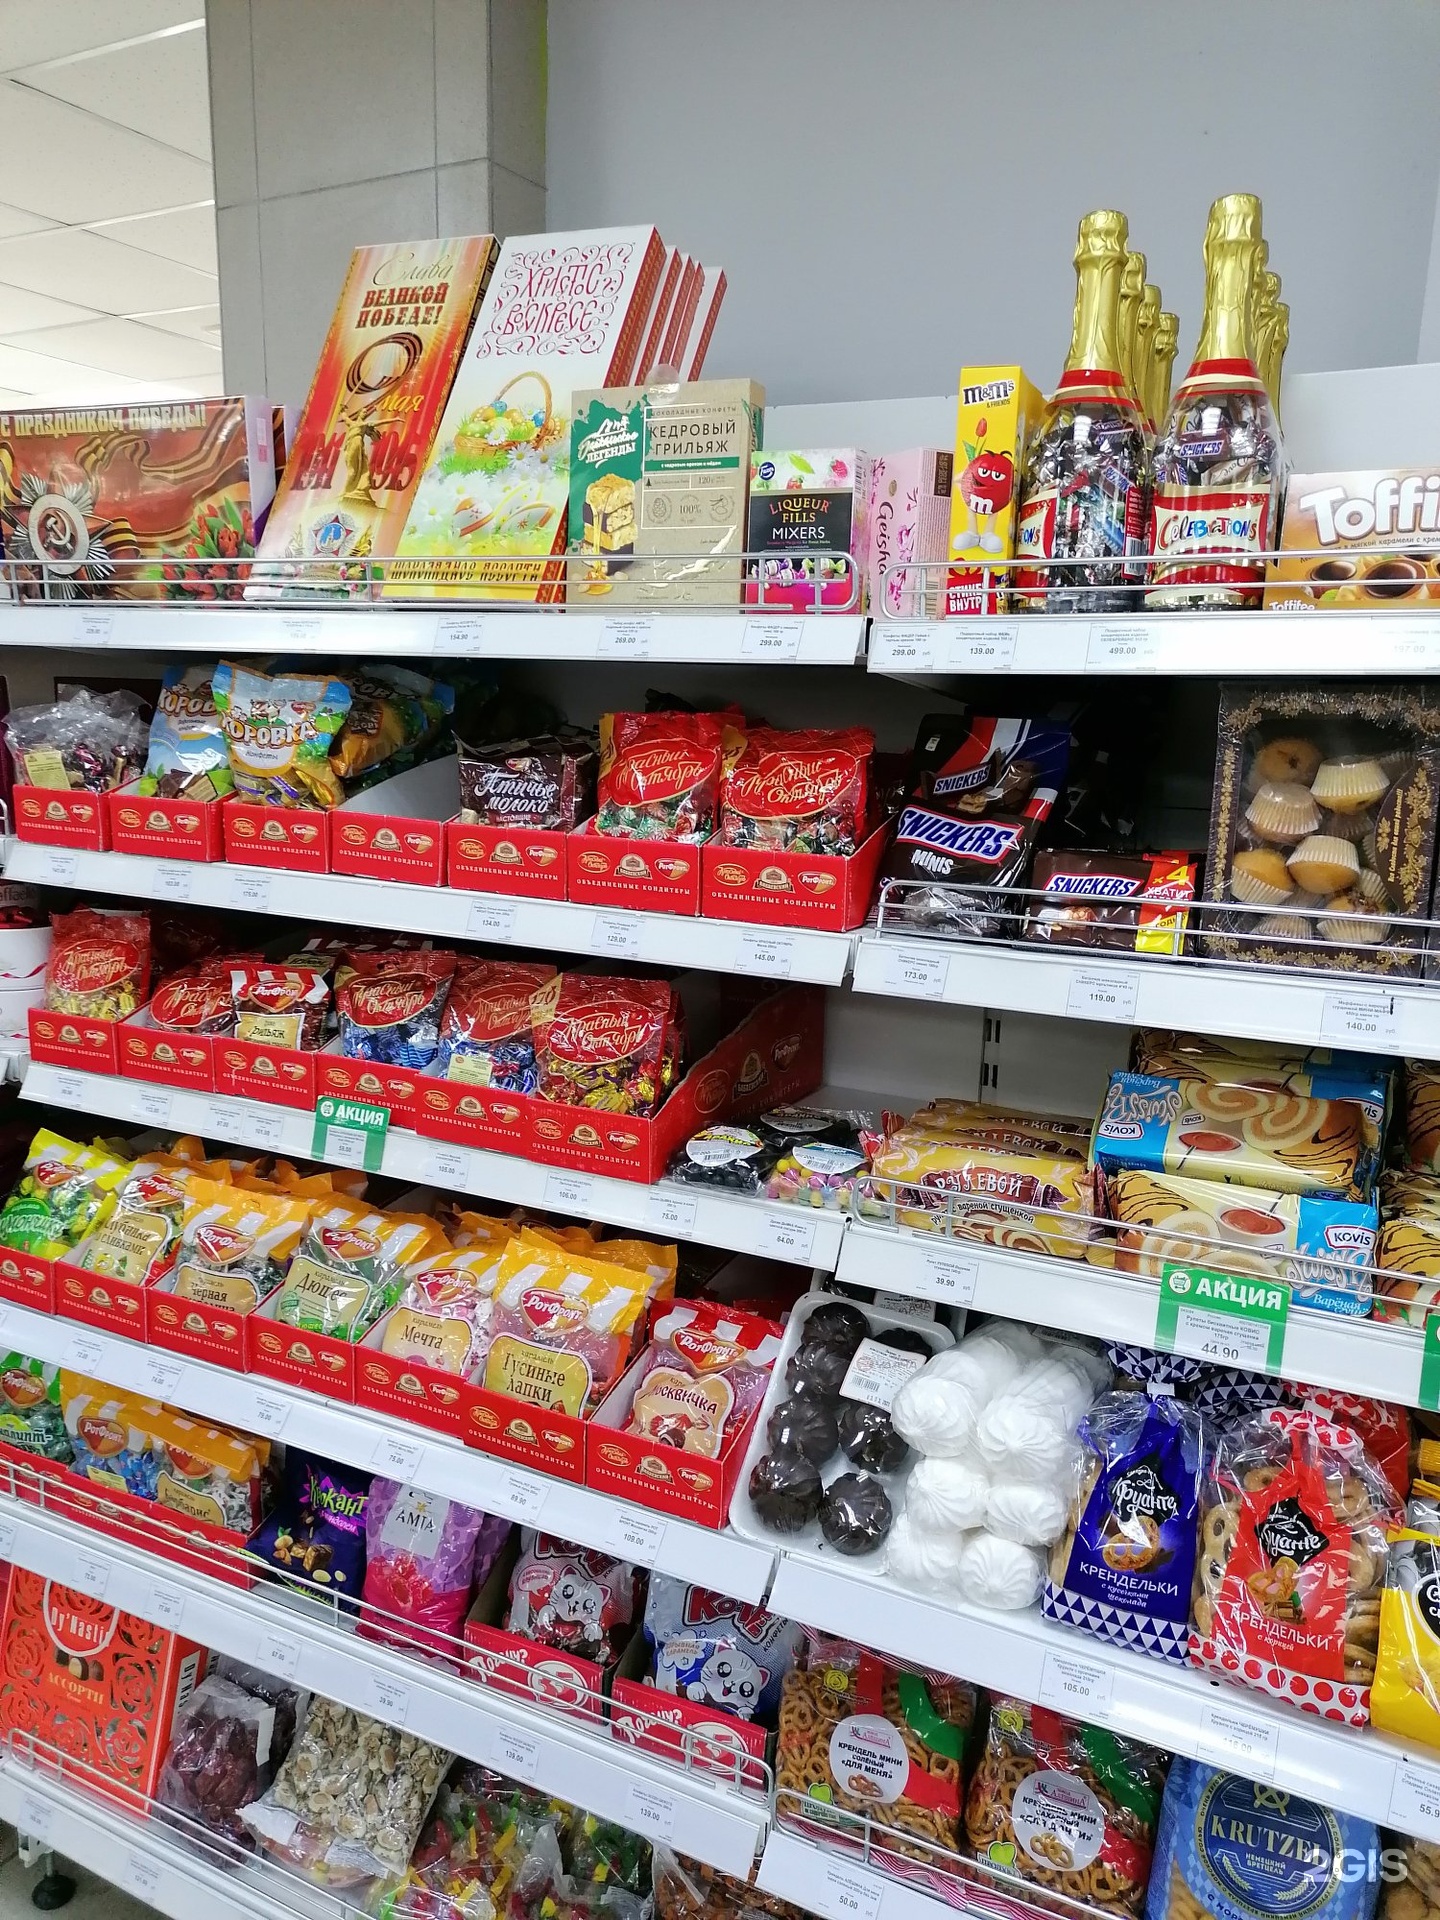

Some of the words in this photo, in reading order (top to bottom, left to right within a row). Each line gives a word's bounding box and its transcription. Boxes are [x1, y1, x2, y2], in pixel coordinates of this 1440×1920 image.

[362, 283, 449, 308] ВЕЛИКОЙ
[355, 304, 443, 329] ПОБЕДЕ!
[15, 409, 124, 438] ПРАЗДНИКОМ
[129, 404, 207, 432] ПОБЕДЫ!
[650, 420, 737, 438] КЕДРОВЫЙ
[654, 440, 729, 455] ГРИЛЬЯЖ
[769, 497, 829, 515] LIQUEUR
[782, 512, 816, 523] FILLS
[772, 526, 826, 540] MIXERS
[876, 501, 894, 576] Geisha
[221, 716, 318, 748] КОРОВКА
[474, 767, 559, 798] Птичье
[935, 769, 990, 793] SNICKERS
[899, 809, 1015, 857] SNICKERS
[456, 865, 512, 876] ОБЪЕДИНЕННЫЕ
[515, 871, 558, 881] КОНДИТЕРЫ
[911, 849, 954, 875] MINIS
[576, 878, 640, 891] ОБЪЕДИНЕННЫЕ
[642, 884, 691, 895] КОНДИТЕРЫ
[1050, 876, 1137, 896] SNICKERS
[712, 891, 780, 905] ОБЪЕДИНЕННЫЕ
[783, 898, 837, 910] КОНДИТЕРЫ
[606, 935, 627, 944] 129.00
[754, 952, 776, 962] 145.00
[903, 970, 928, 981] 173.00
[1088, 993, 1116, 1003] 119.00
[1345, 1021, 1377, 1032] 140.00
[335, 1104, 385, 1128] АКЦИЯ
[532, 1142, 592, 1159] ОБЪЕДИНЕННЫЕ
[594, 1153, 641, 1168] КОНДИТЕРЫ
[990, 1203, 1035, 1223] сгущенкой
[935, 1276, 955, 1288] 39.90
[1195, 1277, 1283, 1311] АКЦИЯ
[526, 1295, 583, 1320] РотФронт
[400, 1324, 444, 1350] Мечта
[680, 1334, 739, 1358] РотФронт
[1201, 1342, 1239, 1361] 44.90
[502, 1352, 566, 1387] Гусиные
[469, 1429, 526, 1454] ОБЪЕДИНЕННЫЕ
[530, 1449, 575, 1470] КОНДИТЕРЫ
[309, 1475, 370, 1517] Крокант
[596, 1467, 660, 1492] ОБЪЕДИНЕННЫЕ
[664, 1489, 714, 1510] КОНДИТЕРЫ
[1079, 1560, 1180, 1598] КРЕНДЕЛЬКИ
[1230, 1609, 1330, 1651] КРЕНДЕЛЬКИ
[1063, 1682, 1090, 1696] 105.00
[838, 1741, 877, 1759] КРЕНДЕЛЬ
[879, 1754, 903, 1767] МИНИ
[1210, 1814, 1330, 1868] KRUTZEL
[1245, 1853, 1286, 1870] НЕМЕЦКИЙ
[839, 1895, 858, 1910] 50.00
